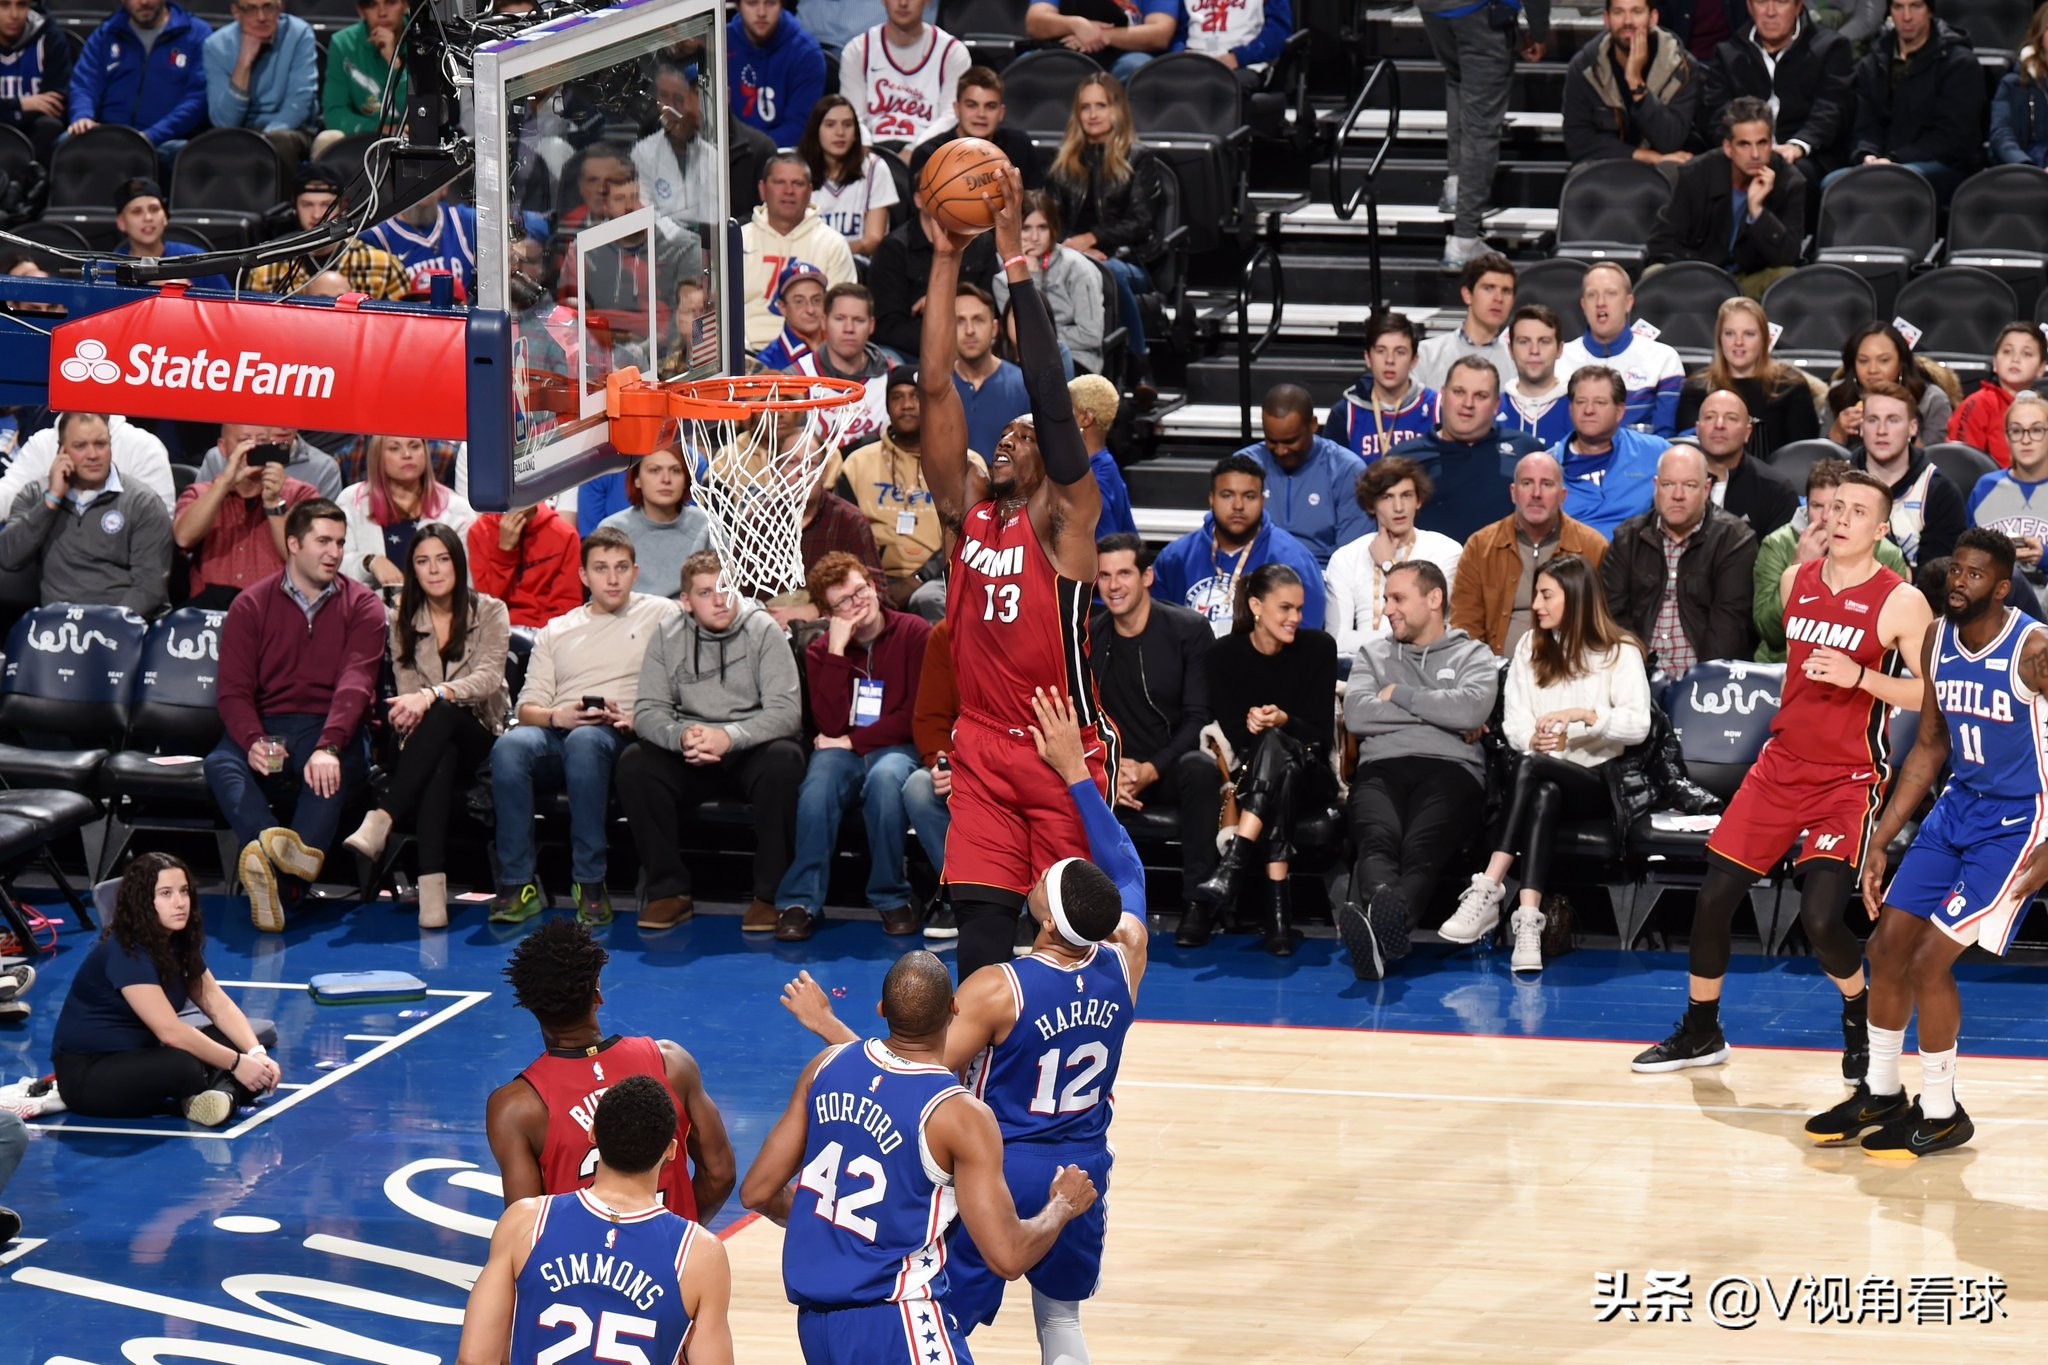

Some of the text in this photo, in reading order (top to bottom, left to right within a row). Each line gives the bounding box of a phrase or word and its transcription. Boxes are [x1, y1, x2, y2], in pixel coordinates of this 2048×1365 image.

[514, 455, 535, 476] PALDING
[983, 582, 1022, 625] 13
[1785, 615, 1866, 652] MIAMI
[1934, 679, 2015, 723] PHILA
[1959, 722, 1985, 766] 11
[1034, 998, 1120, 1041] HARRIS
[1029, 1040, 1109, 1117] 12
[815, 1091, 904, 1156] HORFORD
[798, 1140, 888, 1244] 42
[539, 1252, 665, 1312] SIMMONS
[536, 1302, 657, 1365] 25
